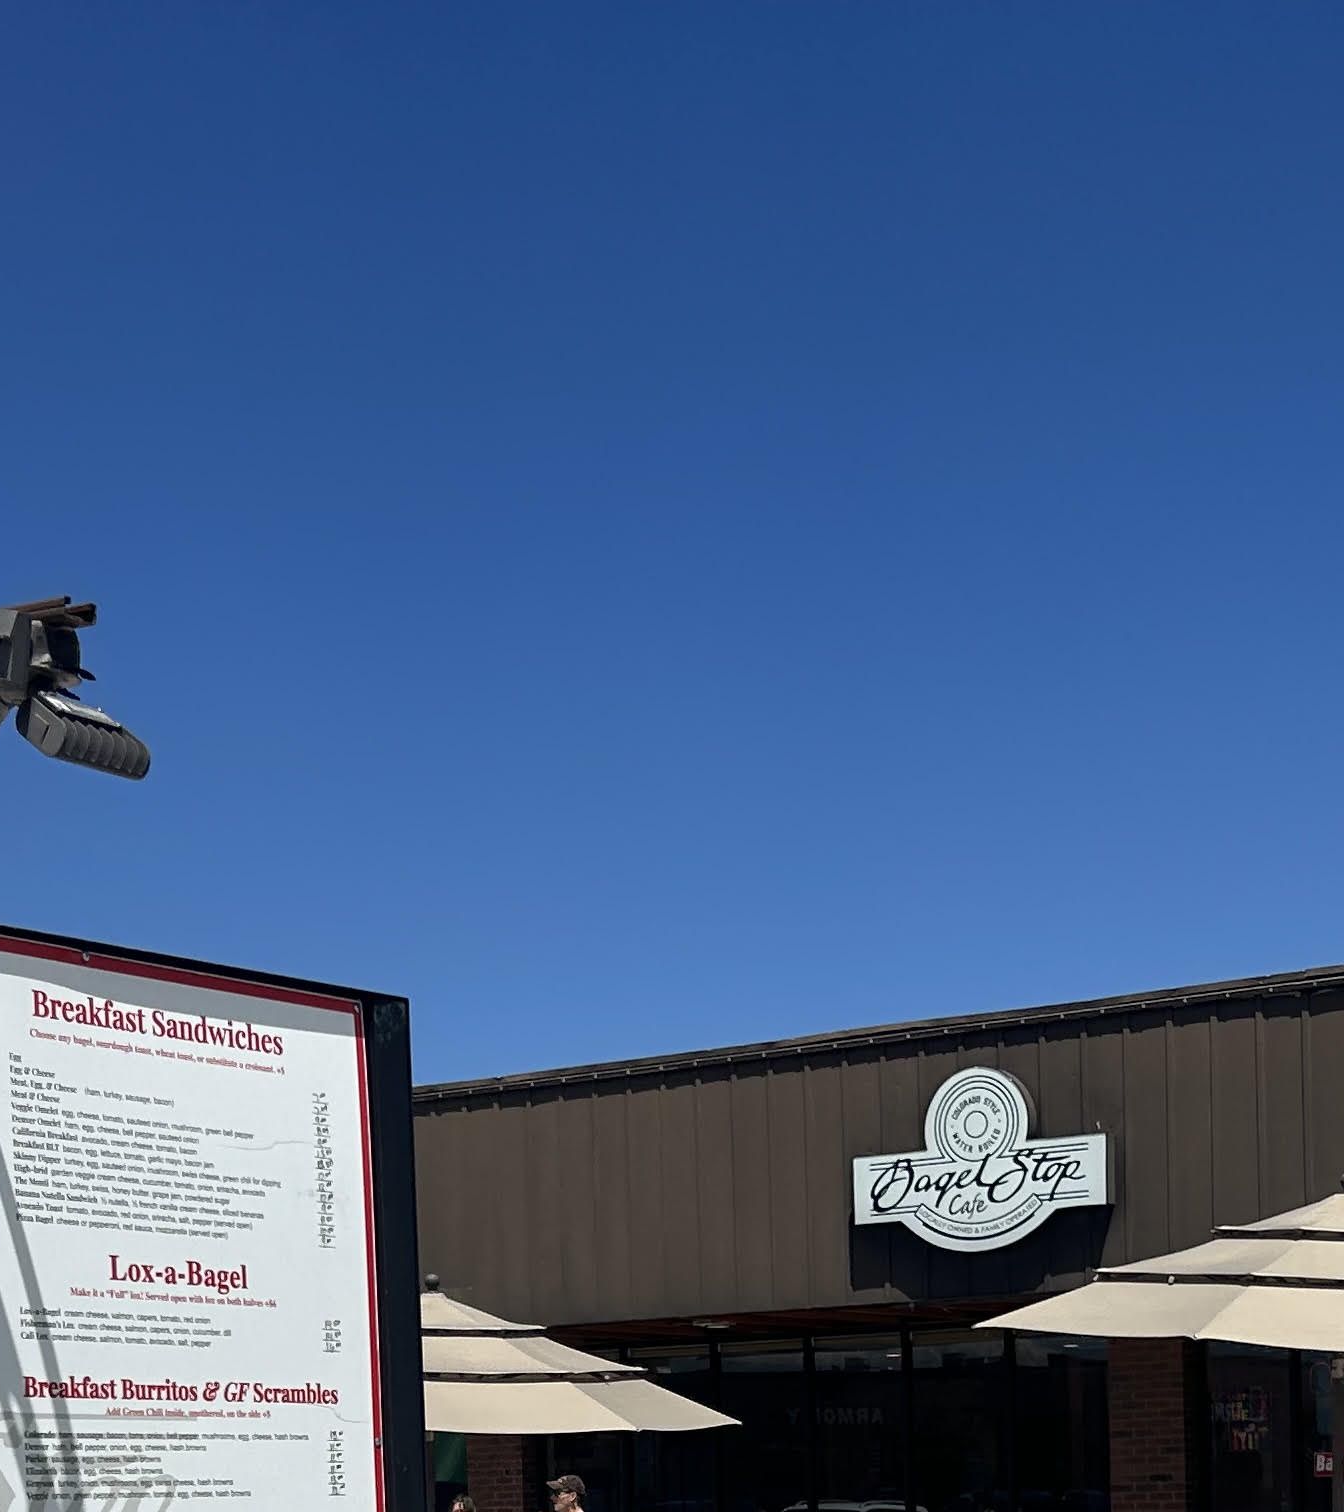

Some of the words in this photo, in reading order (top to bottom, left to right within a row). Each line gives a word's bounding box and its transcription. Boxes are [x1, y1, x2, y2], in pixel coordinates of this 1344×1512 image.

[31, 990, 150, 1033] Breakfast
[149, 1007, 286, 1054] Sandwiches
[952, 1132, 973, 1153] WATER
[871, 1154, 994, 1210] Bagel
[988, 1149, 1085, 1203] Stop
[108, 1255, 248, 1294] Lox-a-Bagel
[22, 1372, 118, 1401] Breakfast
[120, 1379, 198, 1401] Burritos
[202, 1381, 220, 1402] &
[223, 1382, 250, 1402] GF
[252, 1382, 339, 1404] Scrambles
